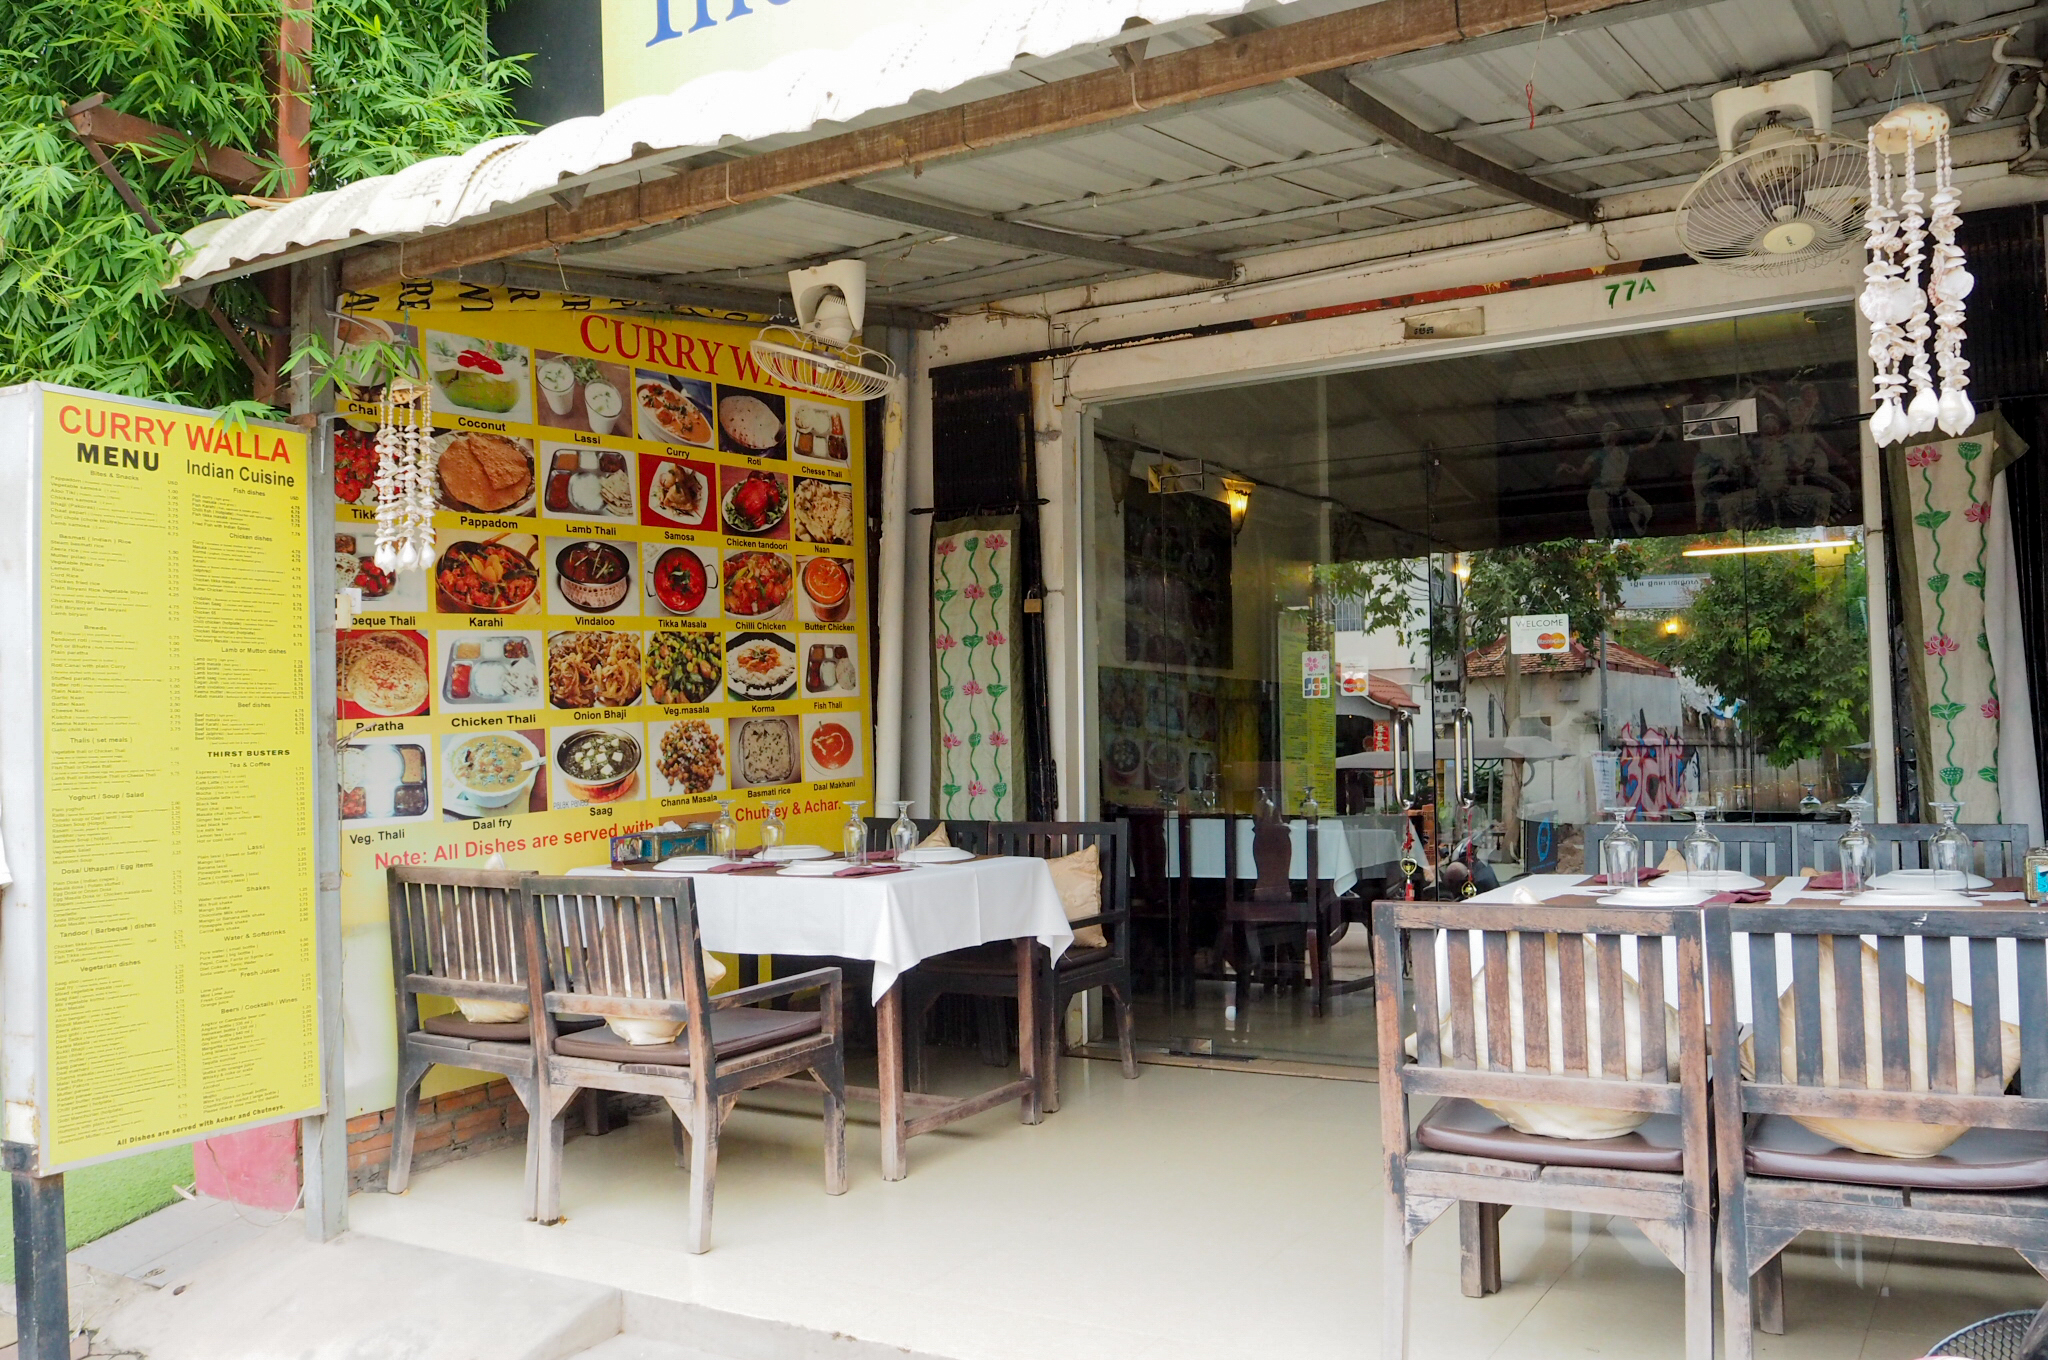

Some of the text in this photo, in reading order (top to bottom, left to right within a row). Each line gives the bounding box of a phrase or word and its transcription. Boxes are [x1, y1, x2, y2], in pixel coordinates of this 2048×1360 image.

[1605, 277, 1656, 309] 77A
[580, 314, 724, 376] CURRY
[348, 403, 378, 416] Chai
[458, 417, 506, 432] Coconut
[59, 405, 291, 464] CURRY WALLA
[574, 432, 601, 445] Lassi
[77, 442, 159, 472] MENU
[666, 447, 690, 460] Curry
[747, 456, 762, 466] Roti
[186, 460, 294, 488] Indian Cuisine
[801, 465, 842, 478] Chesse Thali
[460, 516, 518, 530] Pappadom
[566, 524, 616, 536] Lamb Thali
[664, 532, 694, 542] Samosa
[726, 538, 788, 551] Chicken tandoori
[814, 545, 830, 554] Naan
[390, 616, 416, 626] Thali
[469, 617, 503, 628] Karahi
[574, 616, 614, 626] Vindaloo
[658, 619, 707, 628] Tikka Masala
[735, 620, 786, 630] Chilli Chicken
[804, 622, 855, 632] Butter Chicken
[752, 704, 775, 713] Korma
[828, 701, 843, 709] Thali
[573, 709, 627, 721] Onion Bhaji
[664, 706, 710, 718] Veg.masala
[356, 721, 404, 732] Paratha
[451, 714, 537, 727] Chicken Thali
[830, 781, 856, 790] Makhani
[747, 787, 791, 798] Basmati rice
[660, 794, 718, 807] Channa Masala
[589, 807, 613, 819] Saag
[792, 802, 801, 815] &
[804, 799, 841, 814] Achar.
[472, 818, 512, 831] Daal fry
[350, 829, 405, 846] Veg. Thali
[374, 819, 654, 870] Note: All Dishes are served with
[80, 963, 117, 972] Vegetarian
[117, 1138, 127, 1146] All
[130, 1133, 155, 1144] Dishes
[172, 1123, 197, 1134] served
[199, 1119, 214, 1128] with
[216, 1115, 236, 1124] Achar
